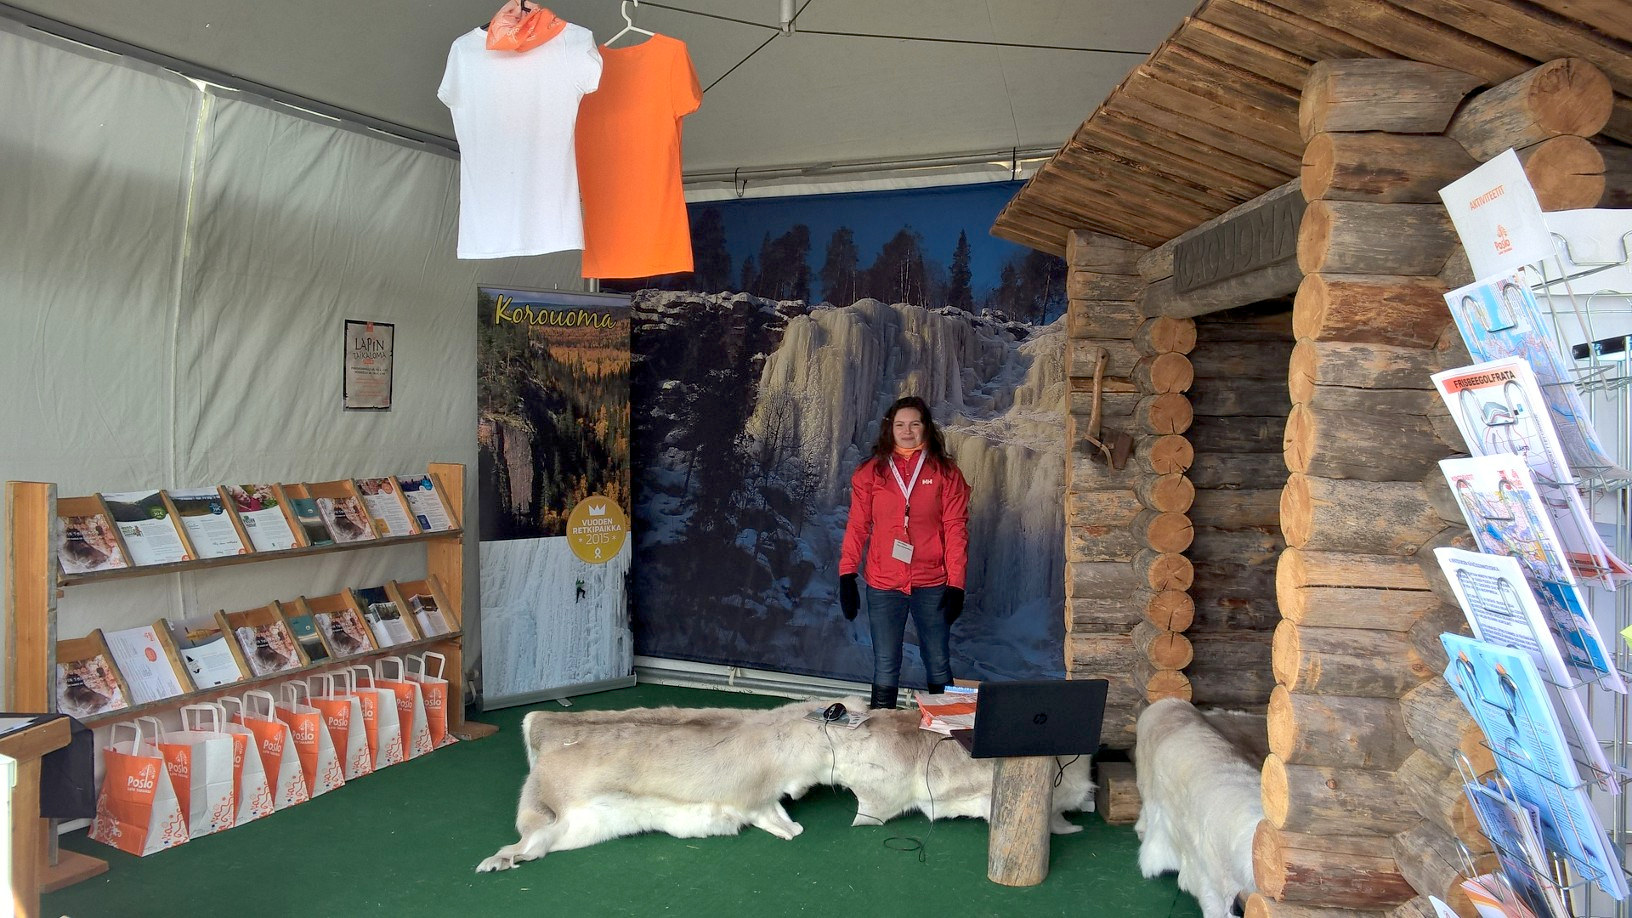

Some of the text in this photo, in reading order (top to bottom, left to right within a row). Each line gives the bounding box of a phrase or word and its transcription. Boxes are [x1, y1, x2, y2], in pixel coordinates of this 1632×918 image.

[1469, 184, 1505, 211] AKTIVITEETIT
[495, 294, 616, 329] Korouoma
[1453, 370, 1516, 388] FRISBEEGOLFRATA
[582, 518, 613, 526] VUODEN
[572, 524, 621, 534] RETKIPAIKKA
[586, 533, 609, 545] 2015
[425, 699, 442, 707] osio
[328, 716, 348, 727] Posio
[263, 739, 282, 753] Posio
[168, 762, 188, 774] Posio
[127, 775, 154, 789] Posio
